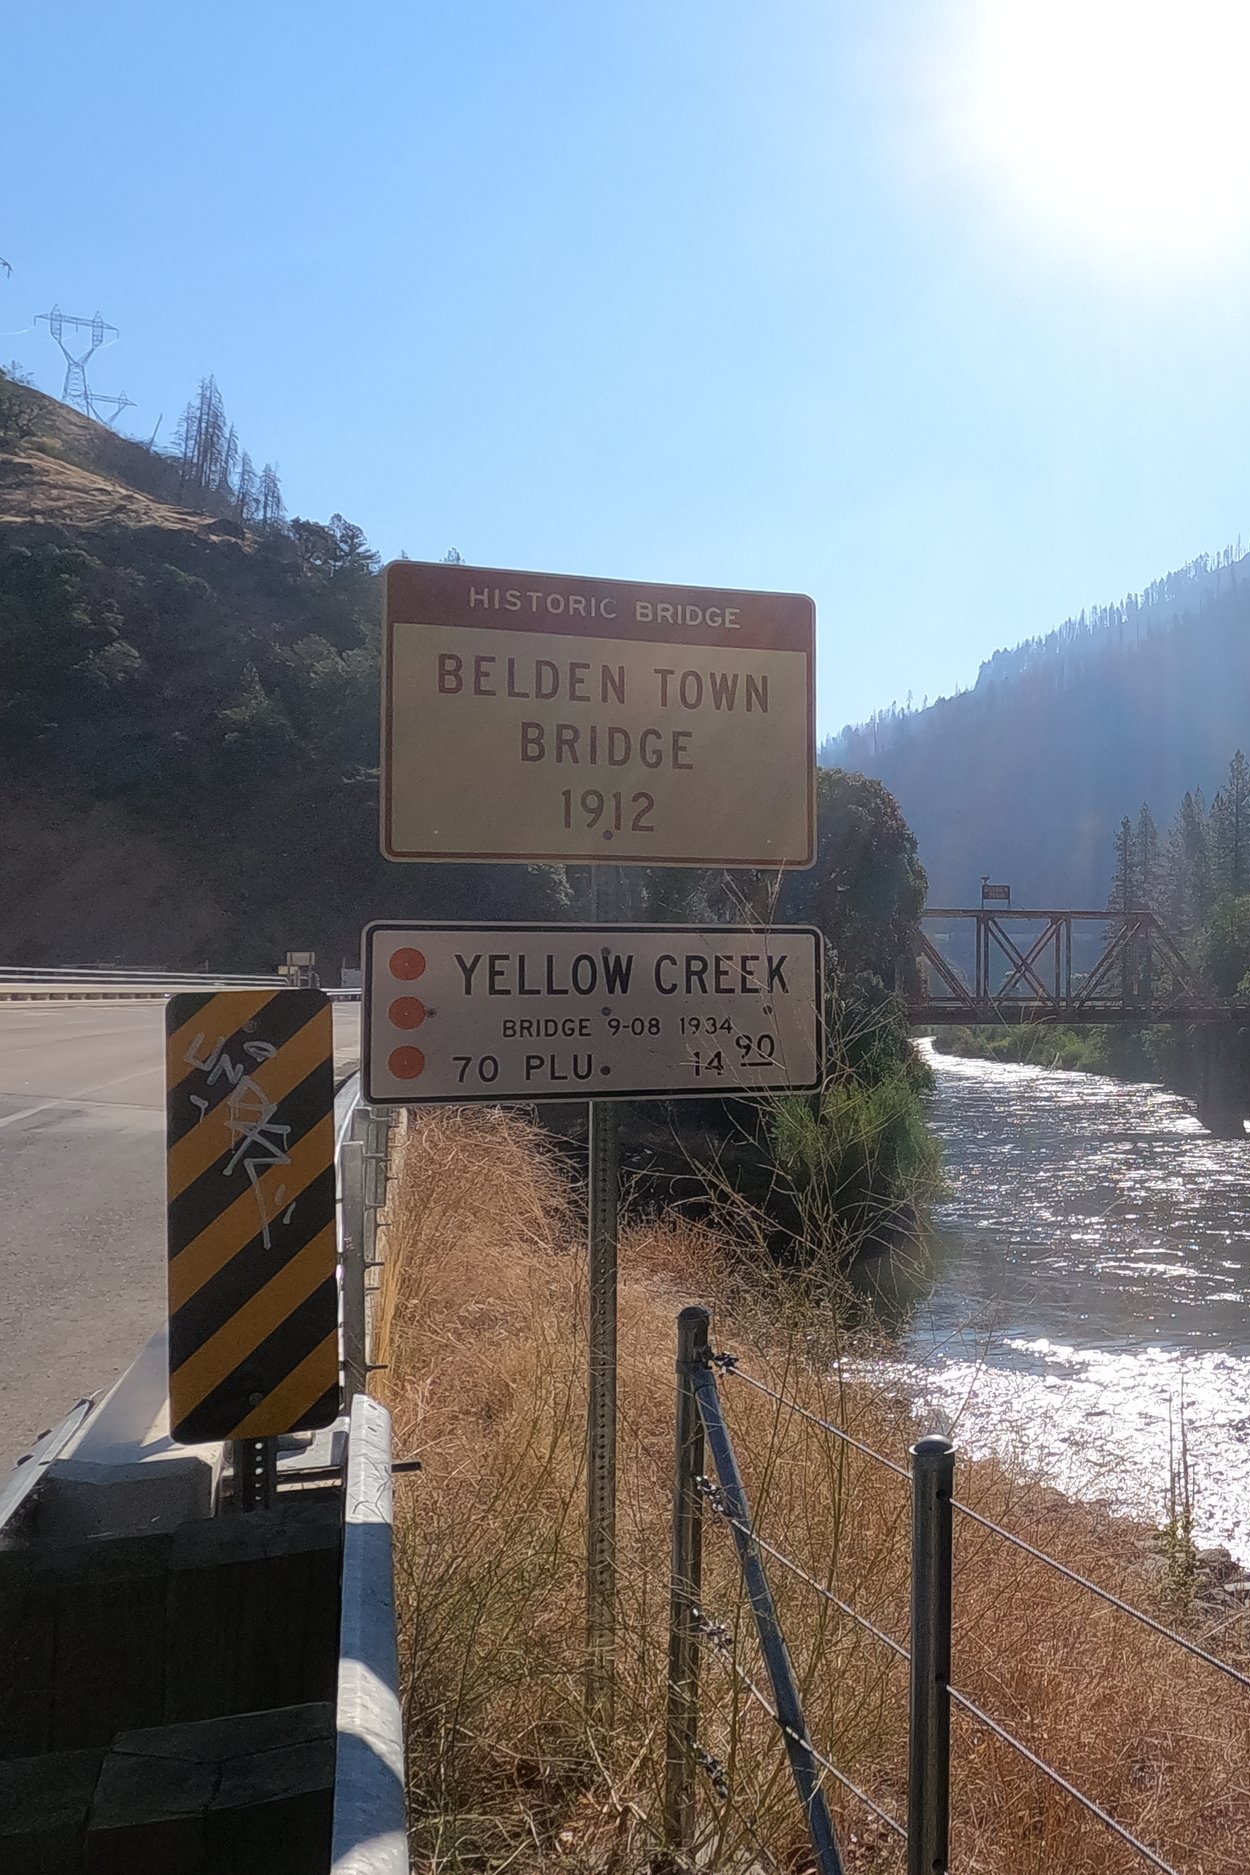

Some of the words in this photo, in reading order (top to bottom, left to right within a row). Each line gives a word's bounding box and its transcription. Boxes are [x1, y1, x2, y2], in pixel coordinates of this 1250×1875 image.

[468, 586, 617, 619] HISTORIC
[635, 600, 741, 629] BRIDGE
[437, 653, 626, 705] BELDEN
[653, 668, 770, 713] TOWN
[520, 721, 694, 770] BRIDGE
[561, 788, 655, 833] 1912
[454, 953, 633, 996] YELLOW
[654, 954, 790, 995] CREEK
[502, 1018, 592, 1037] BRIDGE
[607, 1017, 661, 1036] 9-08
[679, 1017, 733, 1035] 1934
[452, 1056, 500, 1083] 70
[525, 1055, 593, 1081] PLU
